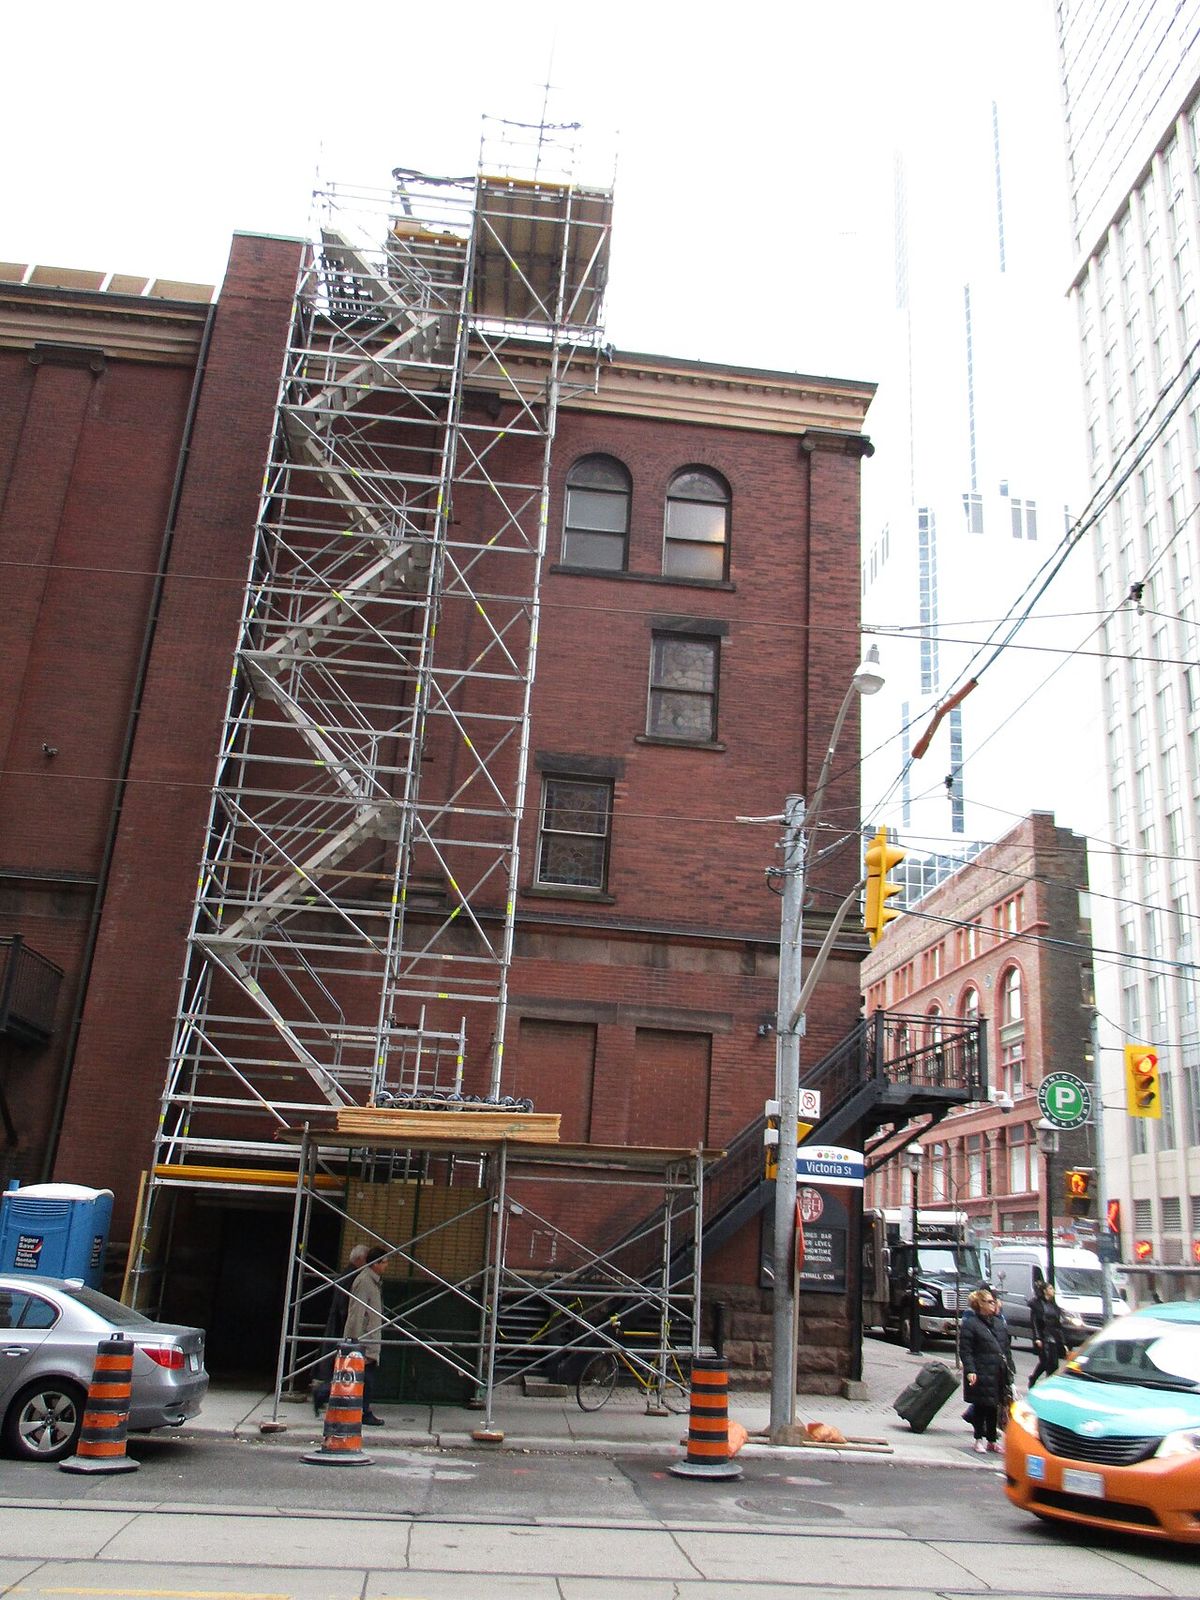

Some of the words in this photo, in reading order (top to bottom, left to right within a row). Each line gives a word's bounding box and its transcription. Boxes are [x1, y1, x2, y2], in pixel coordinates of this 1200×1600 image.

[1056, 1086, 1076, 1109] P
[806, 1161, 842, 1174] Victoria
[844, 1166, 852, 1175] St
